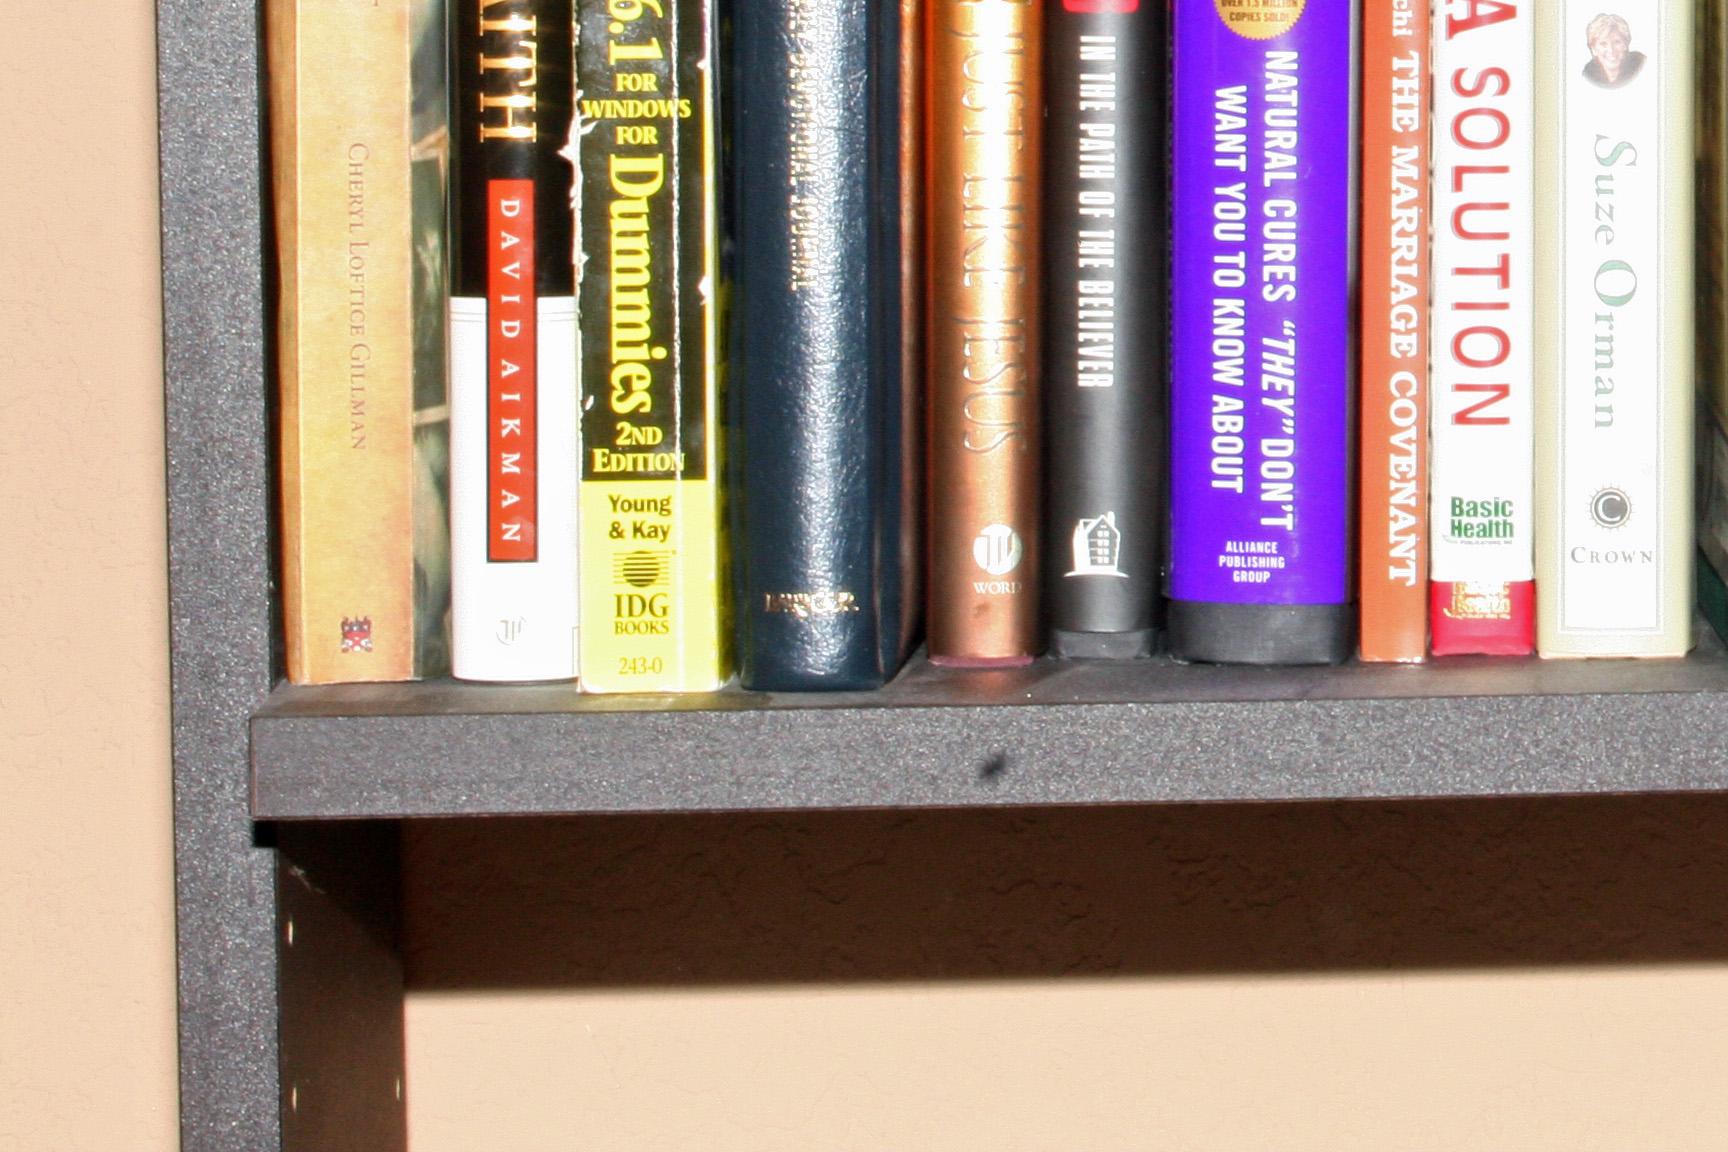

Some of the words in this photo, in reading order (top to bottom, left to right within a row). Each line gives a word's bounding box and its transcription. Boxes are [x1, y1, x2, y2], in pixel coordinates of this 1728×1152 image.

[1080, 35, 1116, 61] IN
[582, 98, 692, 119] WINDOWS
[616, 74, 657, 92] FOR
[946, 28, 1025, 151] JUST
[1079, 72, 1116, 111] THE
[1390, 51, 1420, 130] THE
[616, 126, 659, 145] FOR
[1214, 85, 1248, 172] WANT
[1263, 50, 1299, 187] NATURAL
[1079, 123, 1116, 178] PATH
[348, 143, 370, 234] CHERYL
[1079, 190, 1116, 219] OF
[1213, 182, 1247, 242] YOU
[1593, 133, 1637, 246] Suze
[962, 174, 1025, 288] LIKE
[1079, 229, 1116, 268] THE
[1262, 199, 1298, 302] CURES
[1390, 146, 1420, 359] MARRIAGE
[1451, 66, 1511, 426] SOLUTION
[500, 199, 521, 339] DAVID
[610, 154, 667, 414] Dummies
[1213, 251, 1247, 287] TO
[1078, 280, 1115, 387] BELIEVER
[1212, 298, 1245, 386] KNOW
[1593, 259, 1638, 429] Orman
[349, 343, 371, 450] GILLMAN
[949, 316, 1026, 455] JESUS
[500, 359, 521, 542] AIKMAN
[592, 448, 685, 472] EDITION
[616, 422, 663, 445] 2ND
[1211, 394, 1245, 493] ABOUT
[608, 495, 672, 516] Young
[1260, 439, 1296, 531] DON'T
[1389, 371, 1418, 587] COVENANT
[1450, 496, 1514, 518] Basic
[609, 521, 624, 539] &
[632, 521, 669, 542] Kay
[1225, 542, 1278, 554] ALLIANCE
[1450, 519, 1514, 538] Health
[1570, 546, 1653, 565] CROWN
[1219, 555, 1286, 568] PUBLISHING
[1233, 570, 1271, 583] GROUP
[615, 594, 669, 618] IDG
[615, 620, 669, 635] BOOKS
[619, 657, 662, 674] 243-0
